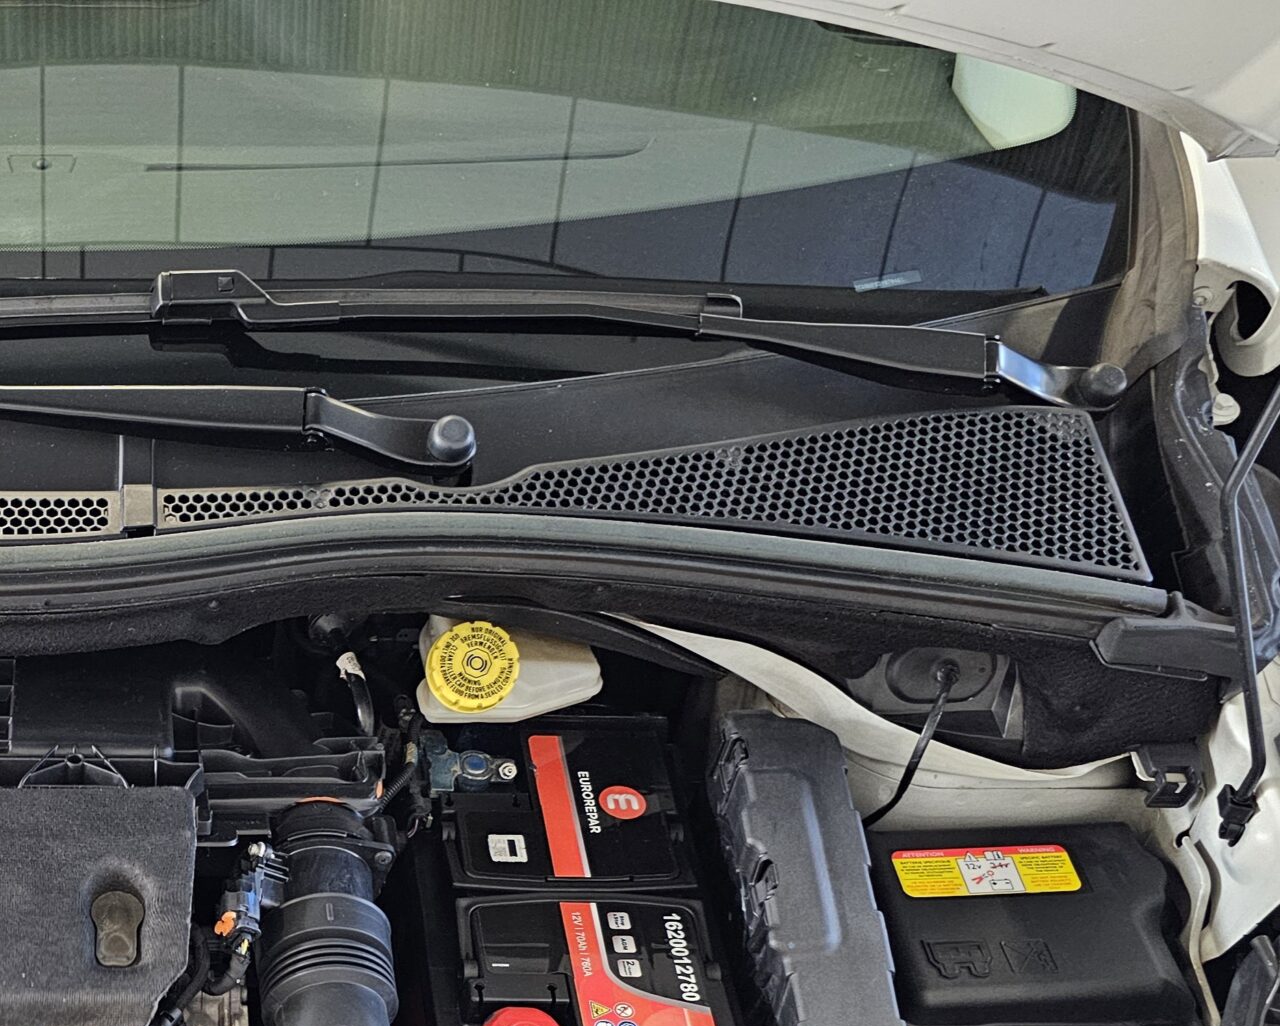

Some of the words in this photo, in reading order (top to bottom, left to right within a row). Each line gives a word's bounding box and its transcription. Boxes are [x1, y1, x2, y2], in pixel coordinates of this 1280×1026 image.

[484, 628, 507, 647] ORIGINAL
[440, 669, 453, 686] BRAKE
[450, 684, 465, 696] FLUID
[484, 685, 503, 699] SEALED
[502, 657, 514, 687] CONTAINER
[454, 679, 466, 689] CAP
[464, 685, 486, 693] BEFORE
[486, 667, 507, 690] REMOVING
[457, 671, 482, 686] WARNING
[576, 770, 602, 835] EUROREPAR
[571, 912, 582, 928] 12V
[575, 931, 586, 951] 70Ah
[663, 913, 701, 1002] 1620012780
